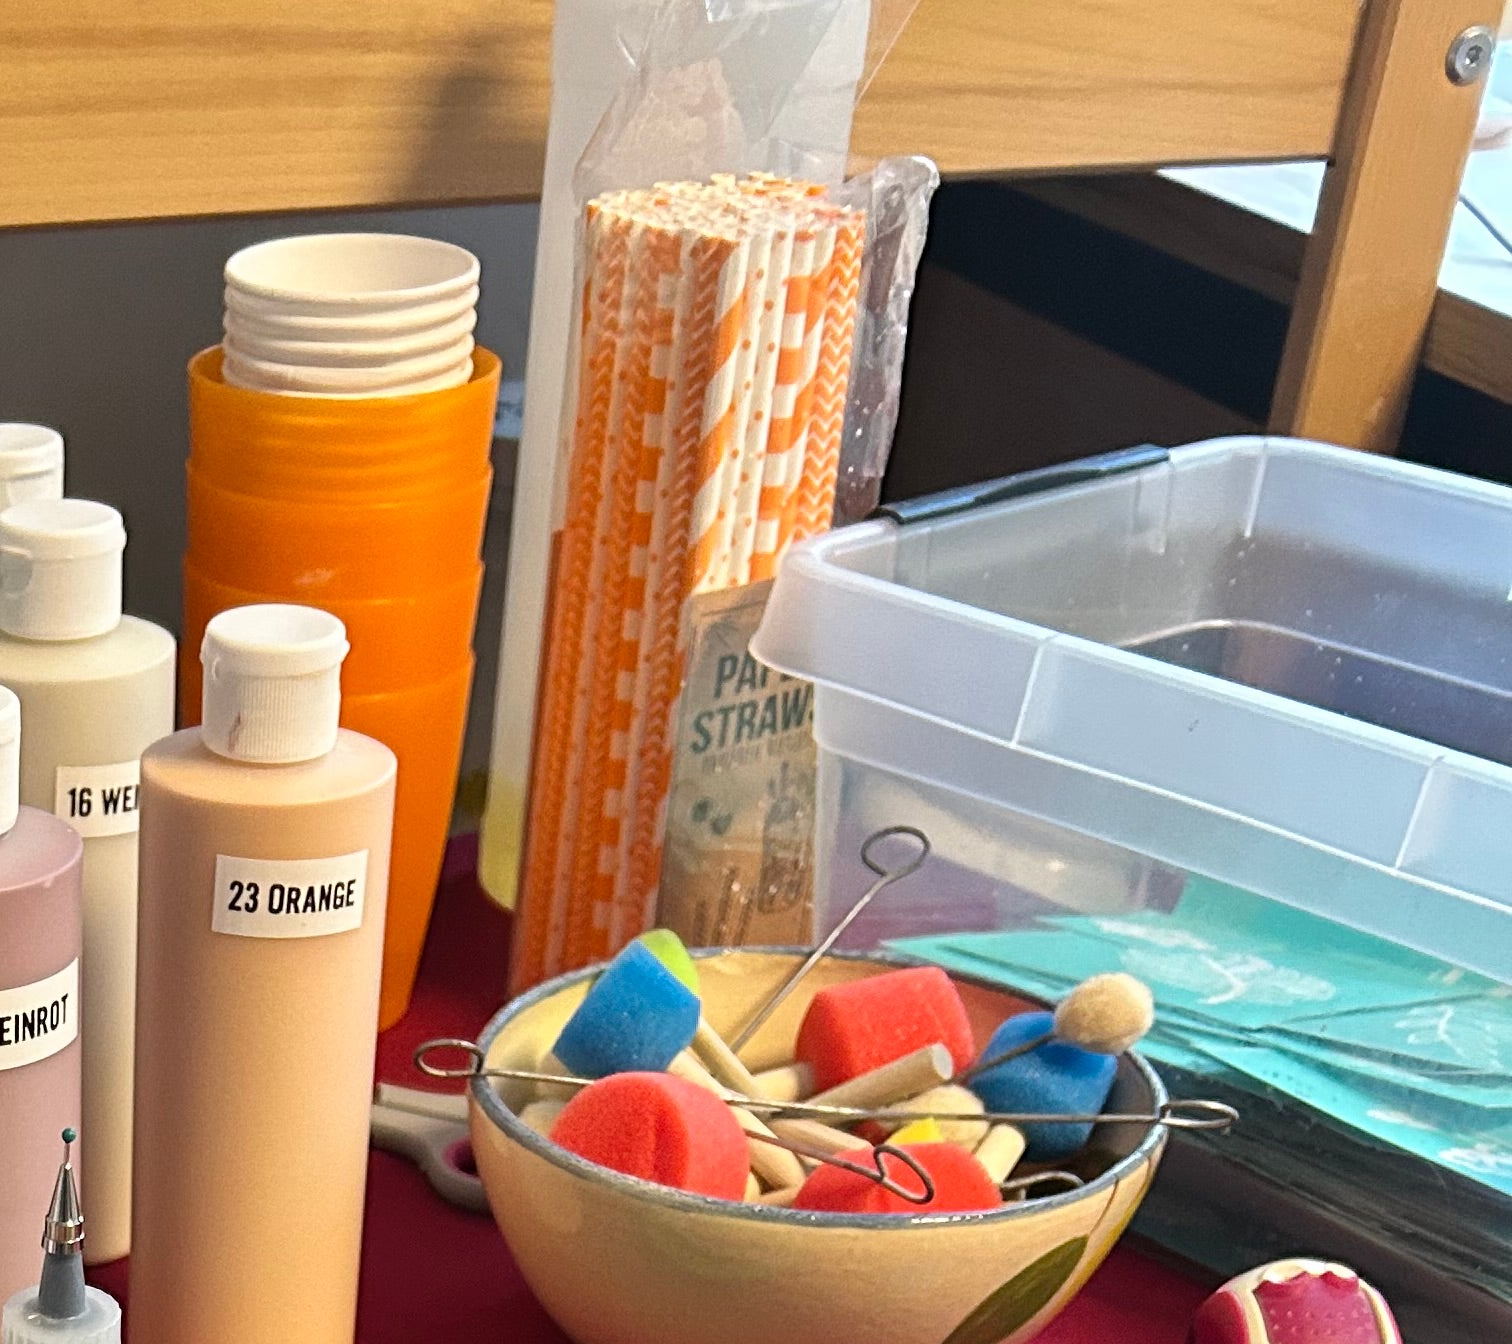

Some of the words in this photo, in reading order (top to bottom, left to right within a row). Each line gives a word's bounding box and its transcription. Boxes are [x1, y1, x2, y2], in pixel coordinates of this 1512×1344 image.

[690, 683, 814, 754] STRAW
[69, 788, 91, 817] 16
[102, 785, 139, 815] WEI
[228, 881, 259, 913] 23
[268, 880, 355, 914] ORANGE
